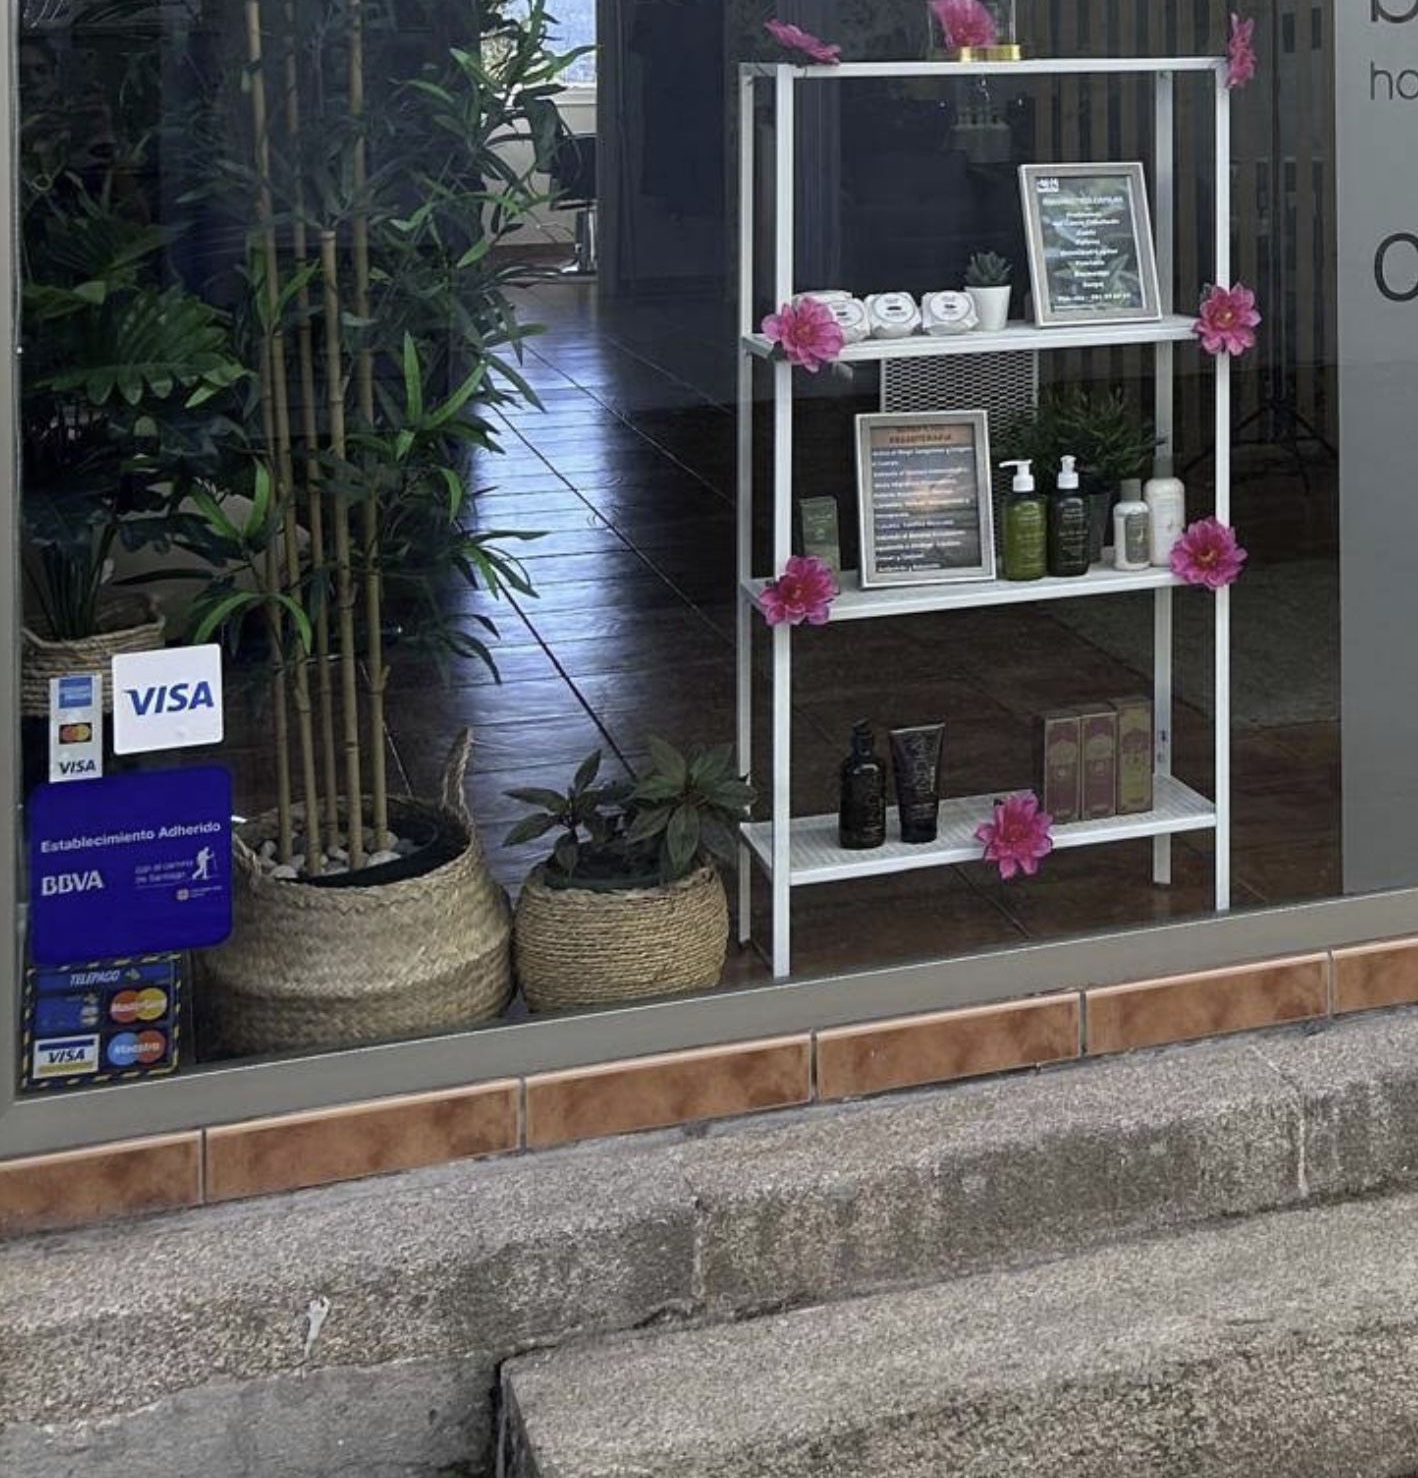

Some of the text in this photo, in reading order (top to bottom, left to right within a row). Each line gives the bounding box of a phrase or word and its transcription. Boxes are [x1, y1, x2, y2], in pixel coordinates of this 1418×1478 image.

[124, 681, 215, 716] VISA
[58, 759, 97, 775] VISA
[40, 821, 221, 854] Establecimiento Adherido
[41, 870, 104, 896] BBVA
[48, 1049, 86, 1064] VISA
